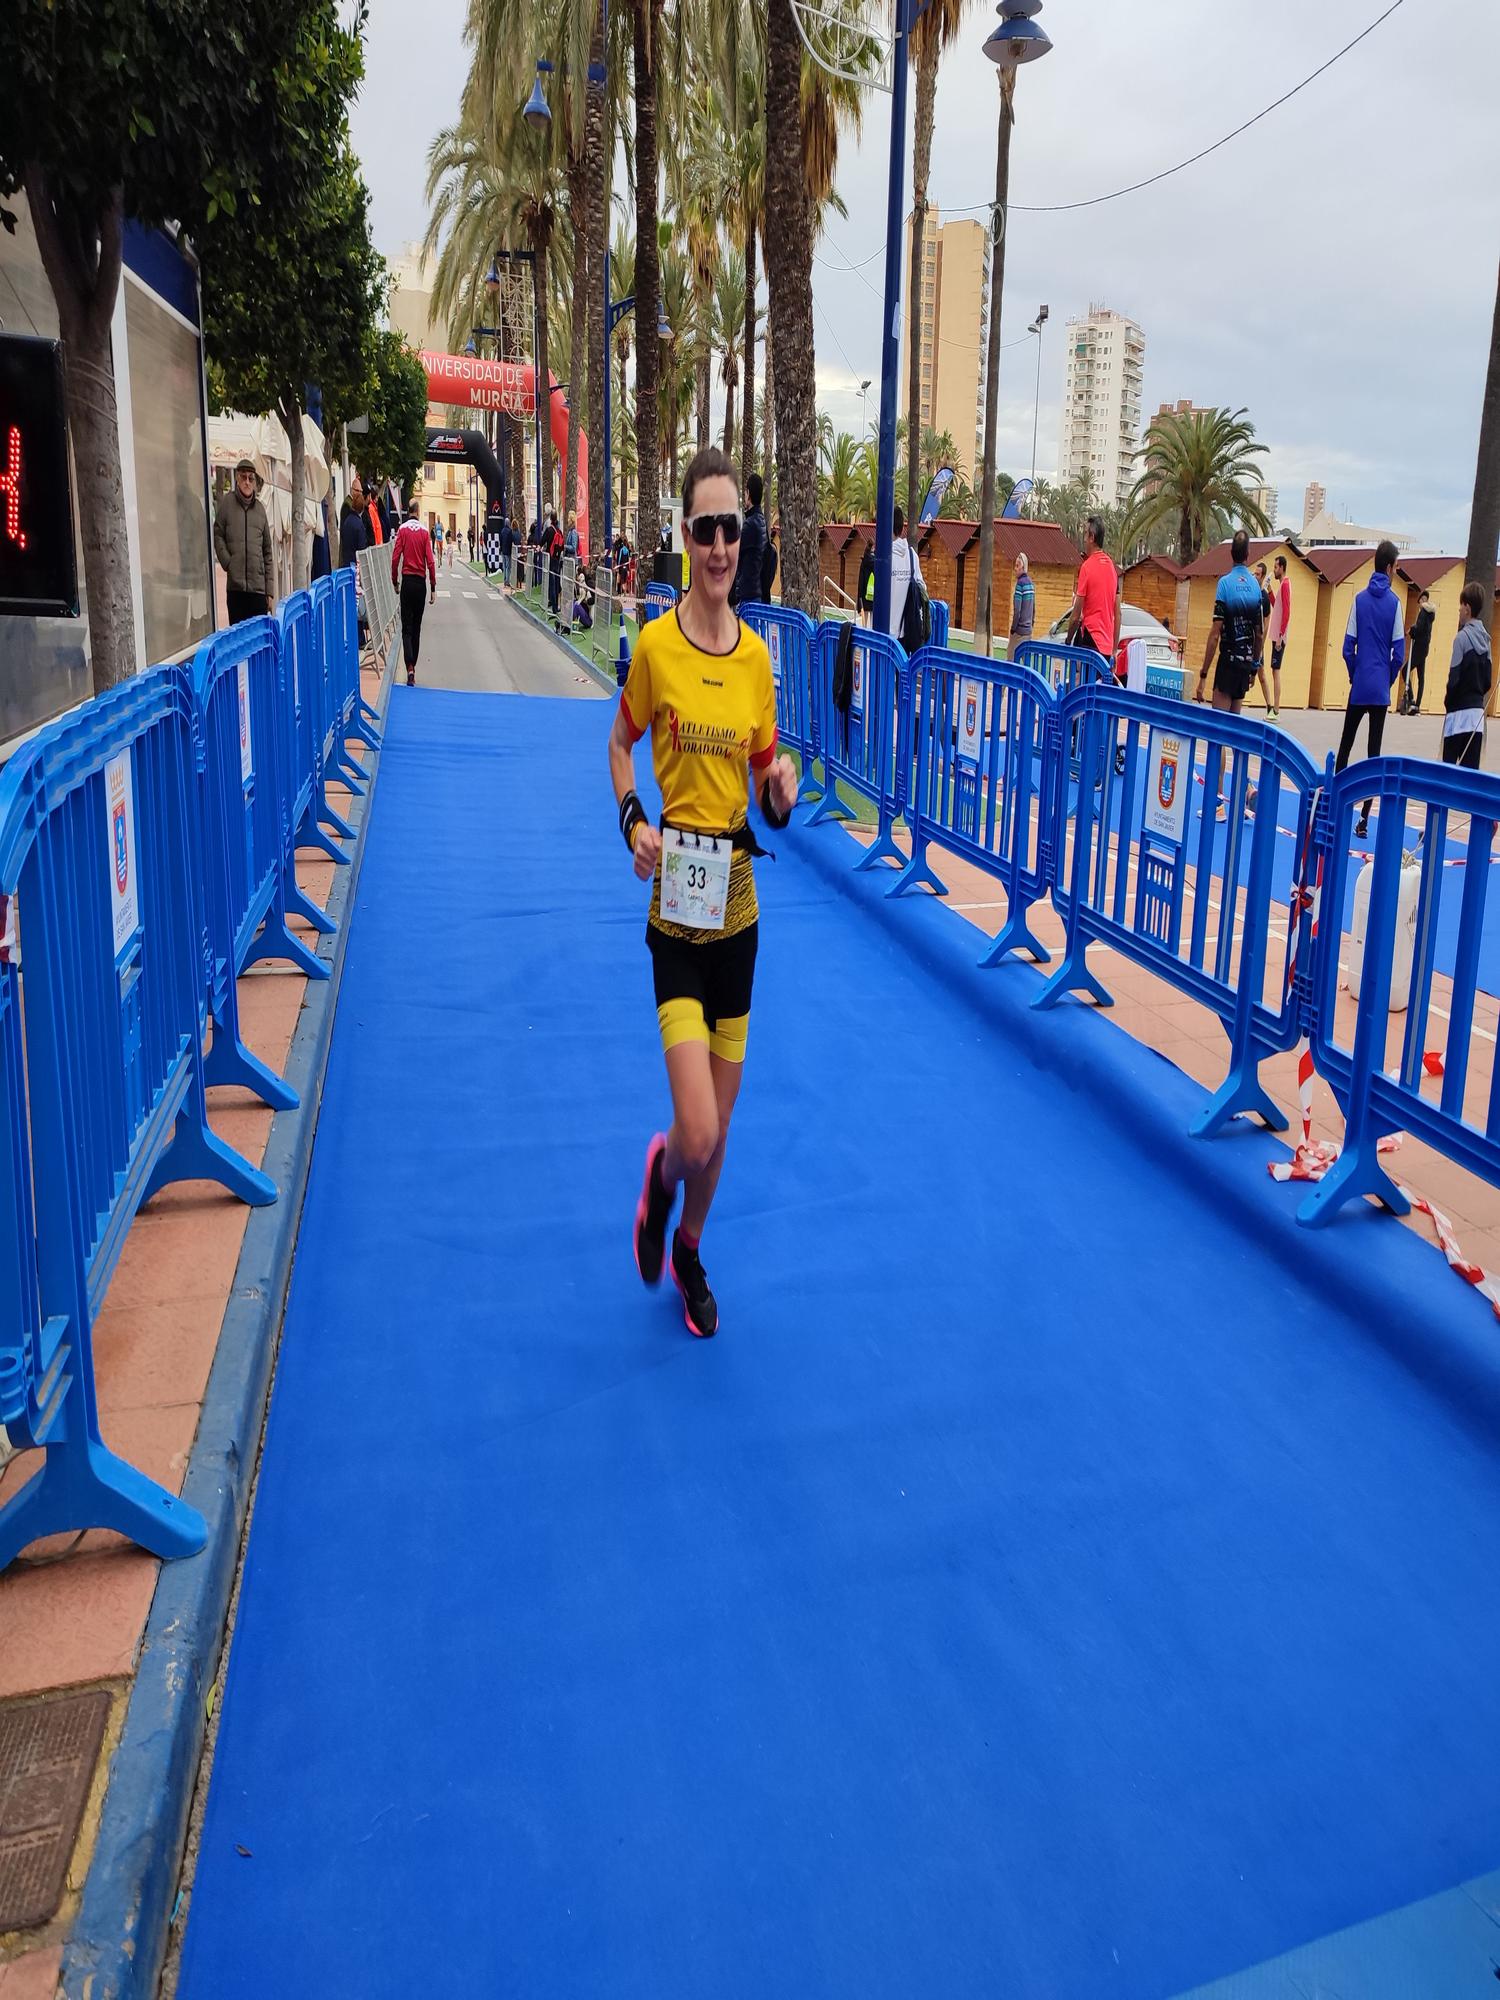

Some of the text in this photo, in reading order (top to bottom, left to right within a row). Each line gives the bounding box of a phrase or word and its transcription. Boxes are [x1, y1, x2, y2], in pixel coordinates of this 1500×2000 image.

[422, 356, 524, 386] NIVERSIDAD DE
[470, 388, 523, 408] MURCIA
[680, 721, 736, 740] ATLETISMO
[687, 864, 706, 890] 33
